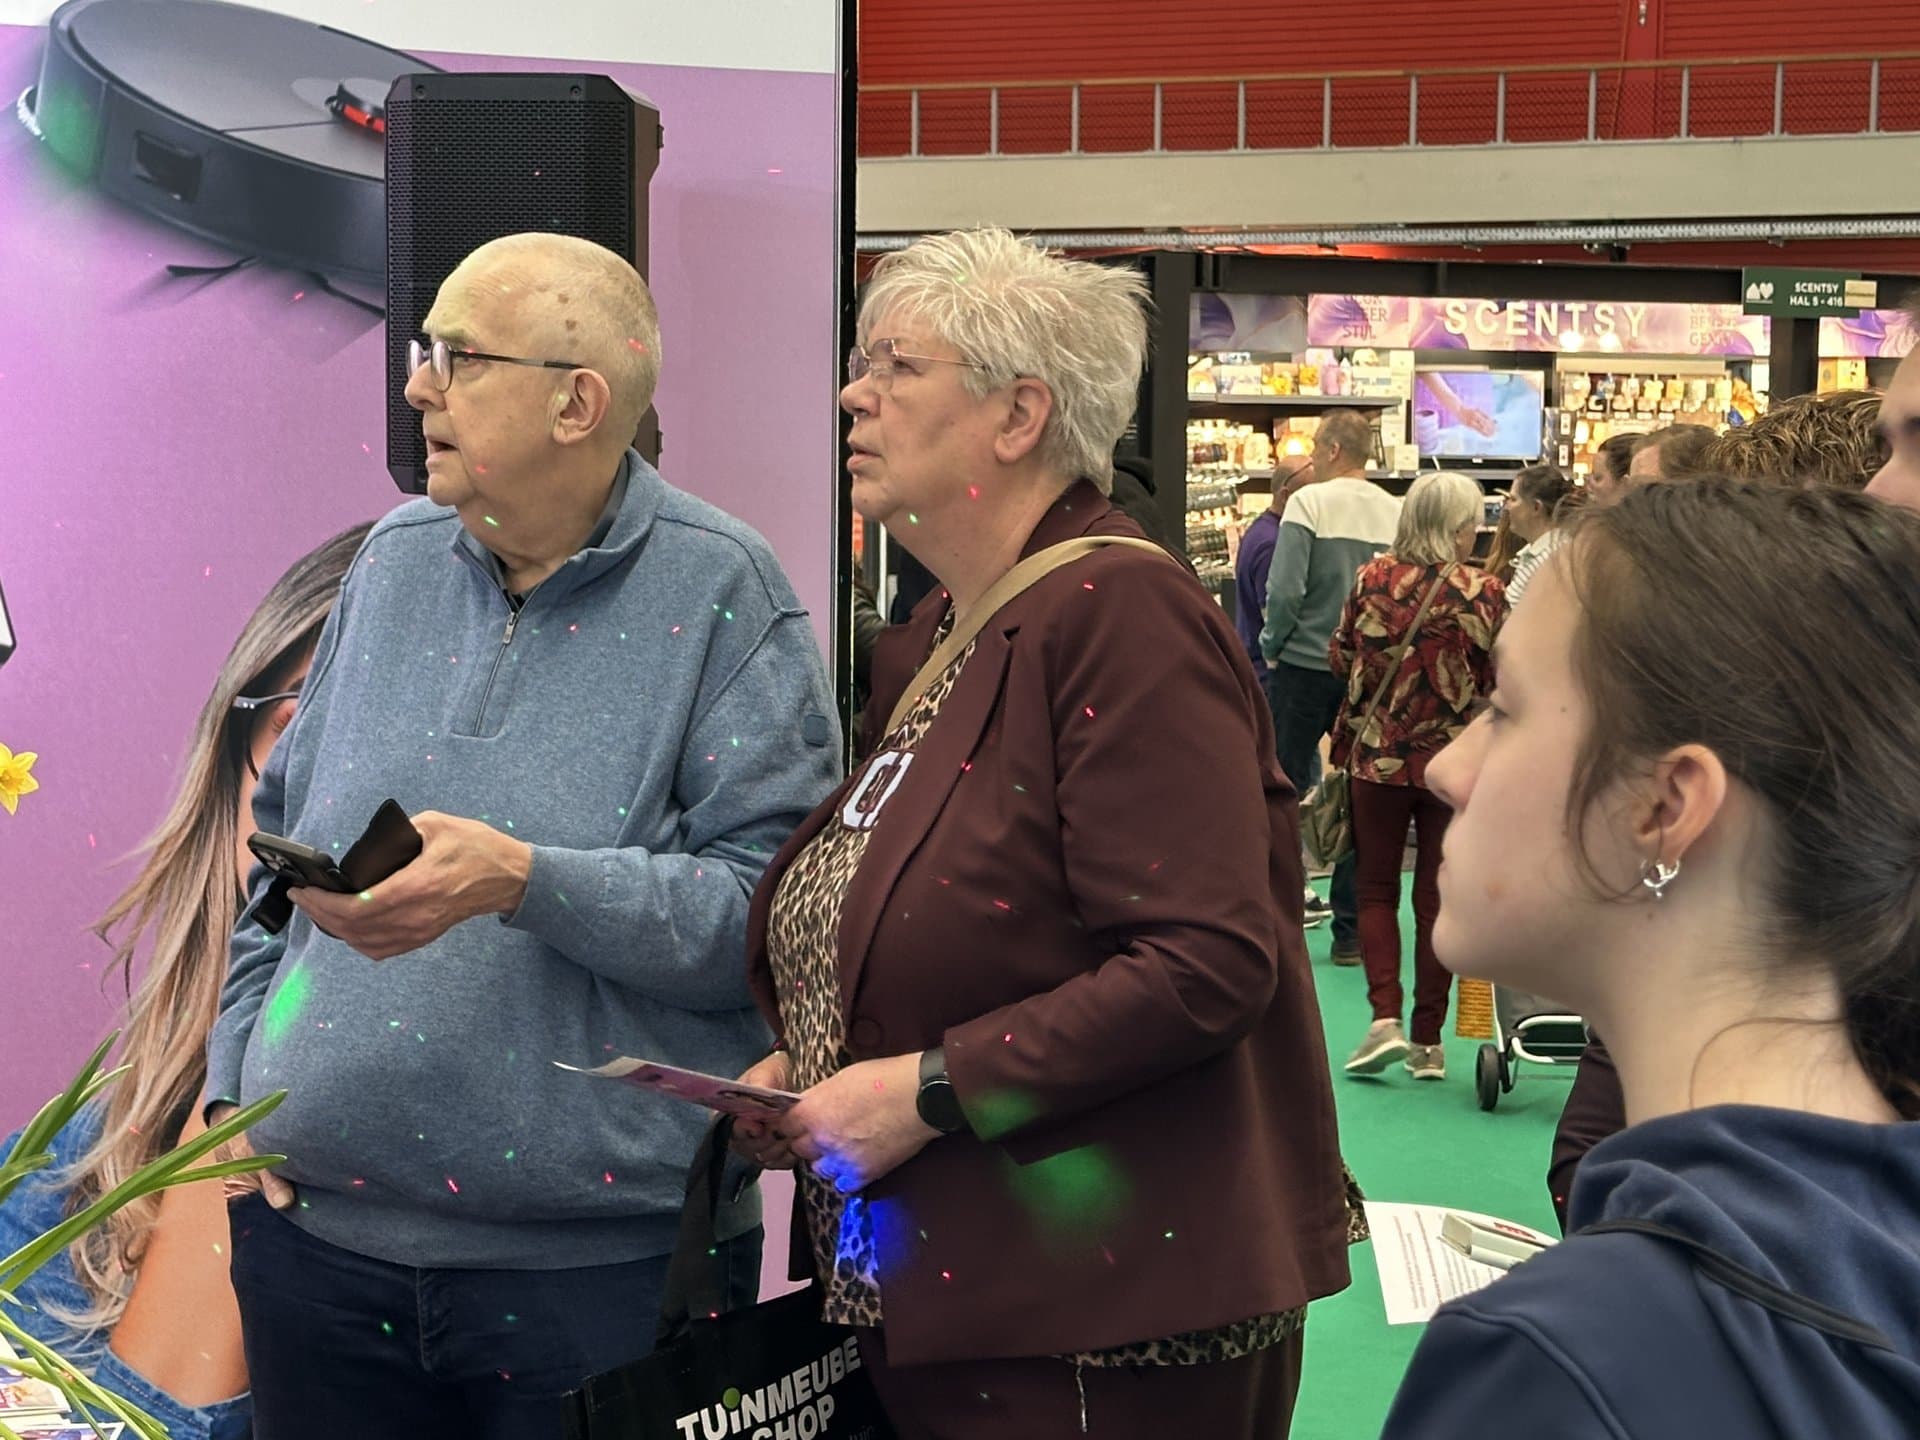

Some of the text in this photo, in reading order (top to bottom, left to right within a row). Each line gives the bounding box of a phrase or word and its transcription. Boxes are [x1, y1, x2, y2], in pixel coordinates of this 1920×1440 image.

[1794, 282, 1839, 294] SCENTSY
[1789, 296, 1811, 306] HAL
[1444, 300, 1647, 338] SCENTSY
